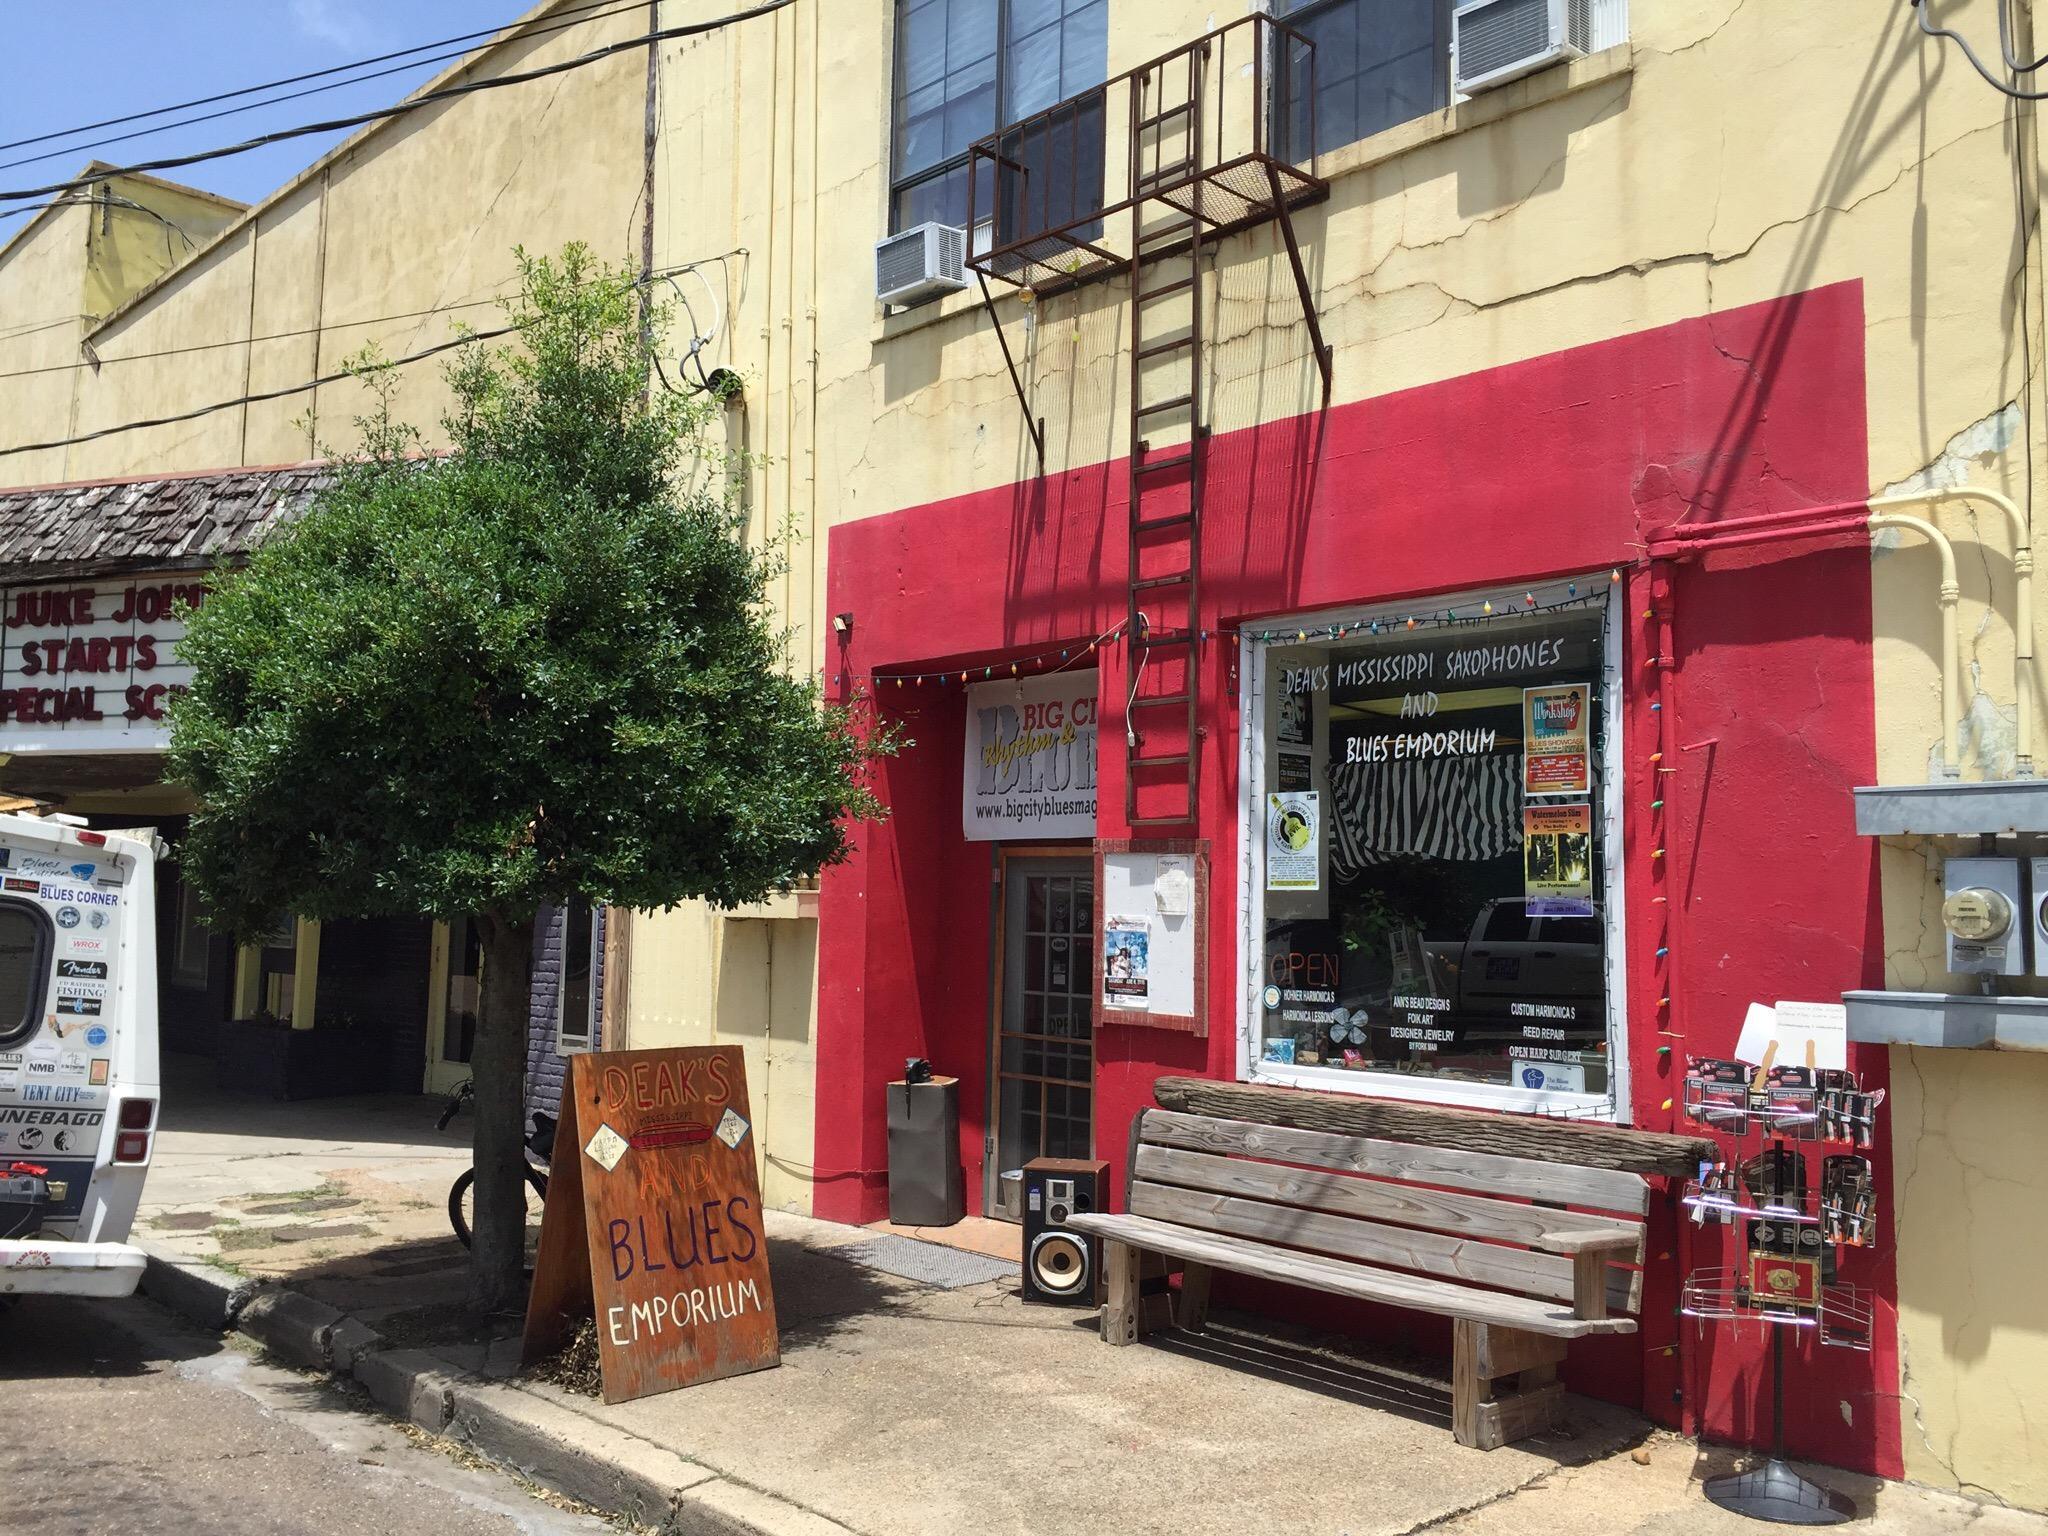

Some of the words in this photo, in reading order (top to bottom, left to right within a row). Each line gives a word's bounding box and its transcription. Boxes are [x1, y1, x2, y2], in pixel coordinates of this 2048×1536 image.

[6, 589, 95, 628] JUKE
[111, 584, 216, 623] JOIN
[20, 635, 157, 675] STARTS
[1286, 665, 1329, 695] DEAK'S
[1337, 652, 1434, 688] MISSISSIPPI
[1446, 637, 1565, 680] SAXOPHONES
[1401, 692, 1439, 719] AND
[1534, 700, 1576, 722] Workshop
[1023, 701, 1065, 731] BIG
[1061, 721, 1077, 745] &
[1346, 736, 1388, 764] BLUES
[1394, 727, 1496, 759] EMPORIUM
[21, 857, 60, 868] Blues
[41, 887, 74, 901] BLUES
[76, 890, 118, 906] CORNER
[73, 940, 101, 949] WROX
[63, 961, 102, 975] Fender
[1271, 952, 1339, 986] OPEN
[57, 986, 107, 998] FISHING!
[1283, 989, 1303, 1002] HOHNER
[1410, 997, 1424, 1009] BEAD
[1511, 1003, 1535, 1016] CUSTOM
[1282, 1010, 1311, 1021] HARMONICA
[1312, 1011, 1334, 1023] LESSONS
[1422, 1014, 1434, 1025] ART
[1391, 1027, 1423, 1039] DESIGNER
[1424, 1030, 1455, 1041] JEWELRY
[1523, 1026, 1540, 1038] REED
[1541, 1028, 1565, 1040] REPAIR
[1509, 1046, 1528, 1058] OPEN
[1529, 1047, 1548, 1059] HARP
[1549, 1049, 1582, 1062] SURGERY
[28, 1062, 55, 1073] NMB
[605, 1054, 730, 1112] DEAK'S
[23, 1084, 53, 1101] TENT
[55, 1086, 80, 1102] CITY
[640, 1111, 694, 1126] MISSISSIPPI
[640, 1154, 712, 1200] AND
[608, 1196, 757, 1282] BLUES
[608, 1278, 762, 1346] EMPORIUM
